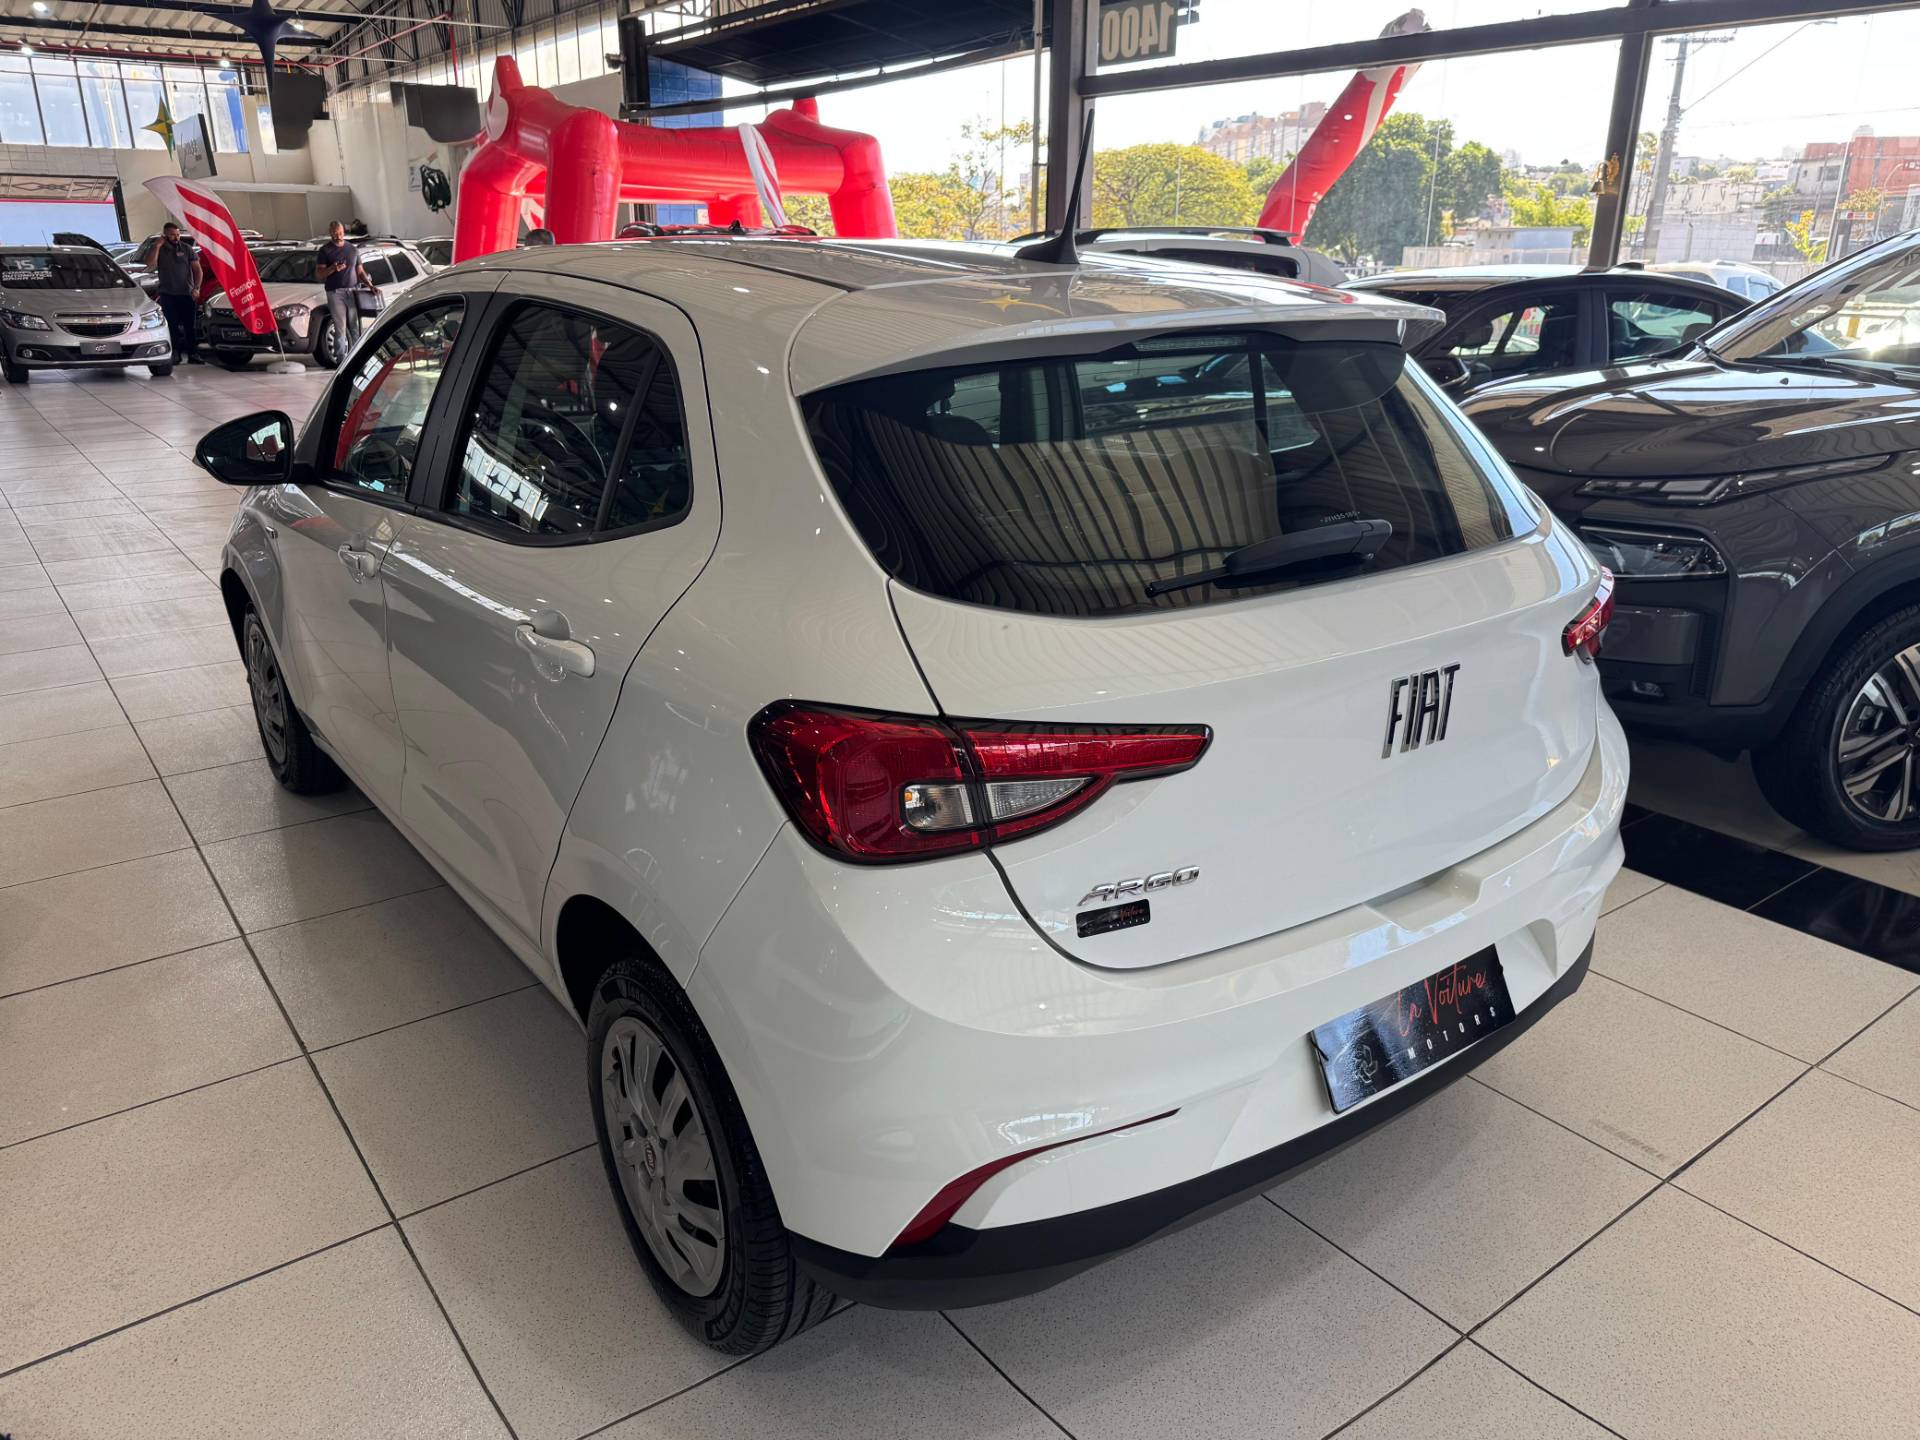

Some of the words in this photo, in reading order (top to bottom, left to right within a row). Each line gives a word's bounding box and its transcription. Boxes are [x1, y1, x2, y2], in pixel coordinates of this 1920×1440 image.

[1381, 661, 1460, 759] FIAT
[1077, 865, 1200, 906] ARGO
[1423, 963, 1487, 1024] Voiture
[1407, 1006, 1496, 1060] MOTORS
